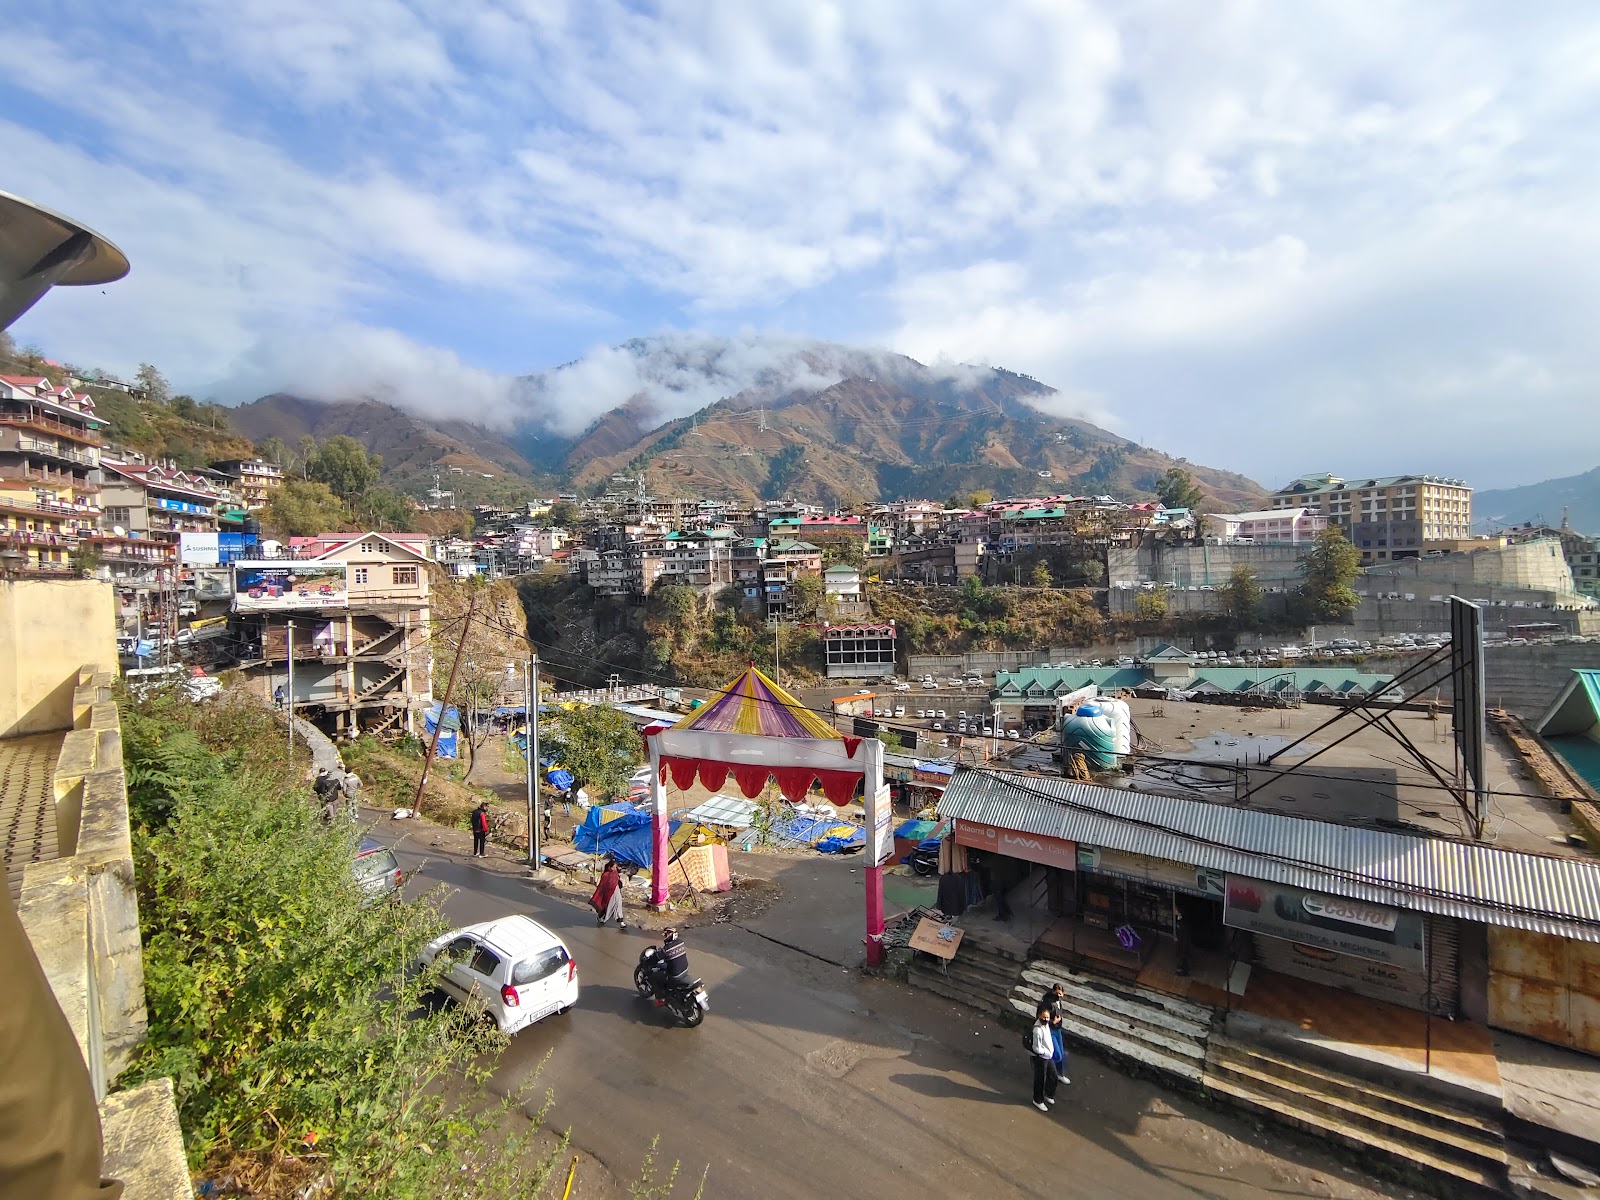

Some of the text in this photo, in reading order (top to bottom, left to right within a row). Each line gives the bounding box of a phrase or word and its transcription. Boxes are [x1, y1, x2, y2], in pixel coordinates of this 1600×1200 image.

[959, 823, 985, 836] Xiaomi
[1004, 833, 1043, 851] LAVA
[1048, 843, 1068, 856] Care
[1165, 857, 1196, 871] Services
[1324, 900, 1389, 927] Castrol
